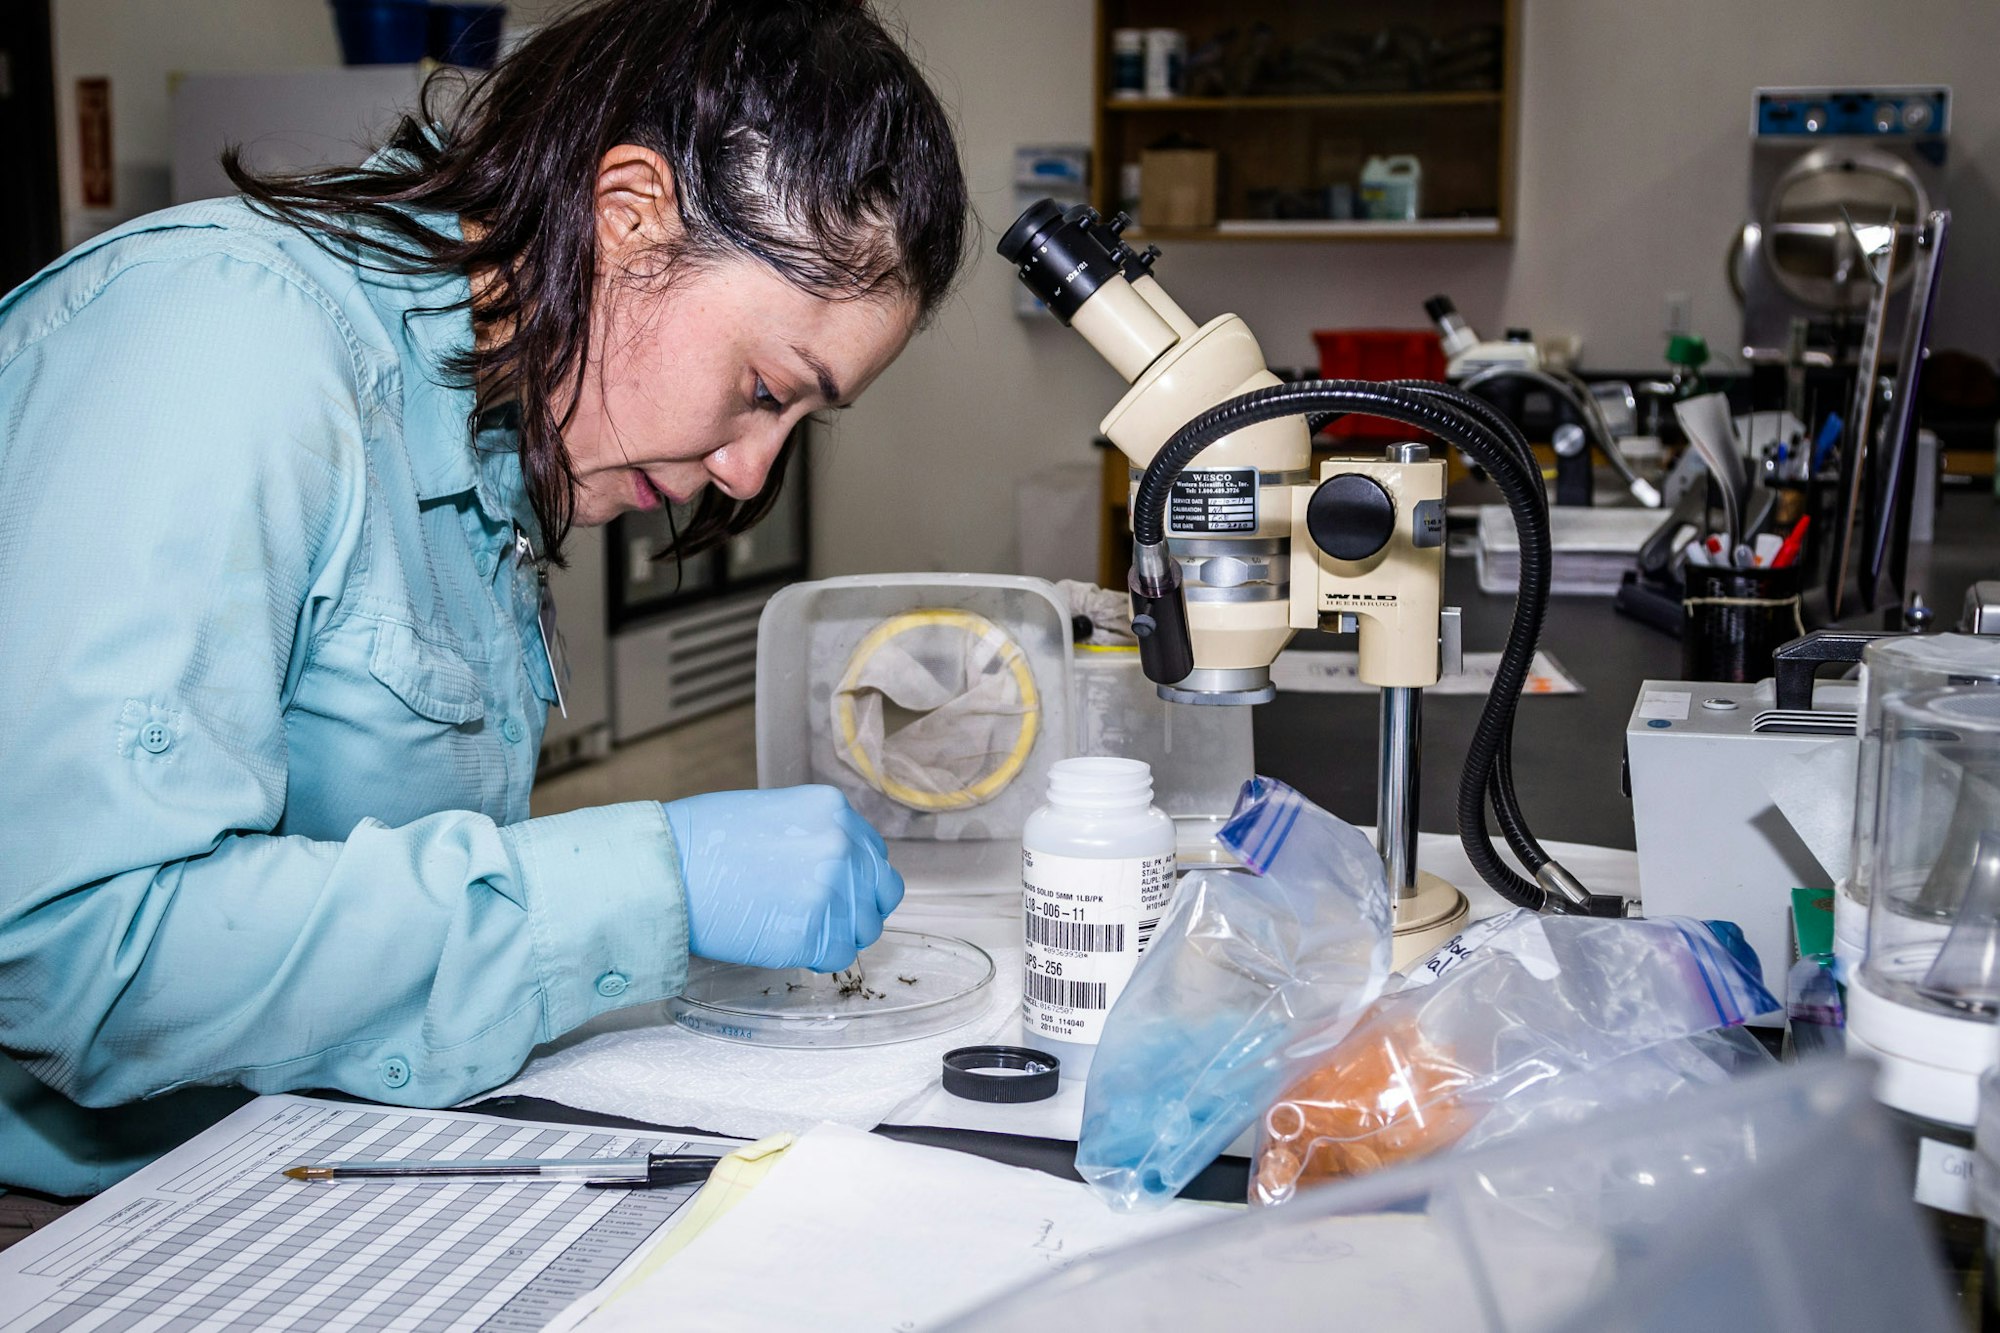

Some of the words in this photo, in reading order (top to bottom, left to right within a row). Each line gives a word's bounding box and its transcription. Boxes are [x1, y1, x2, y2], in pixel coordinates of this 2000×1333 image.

[1192, 473, 1232, 482] WESCO
[1037, 887, 1054, 898] SOLID
[1142, 894, 1158, 902] Order
[1041, 1013, 1053, 1023] CUS
[1059, 1018, 1084, 1028] 114040
[1040, 1022, 1072, 1035] 20110114
